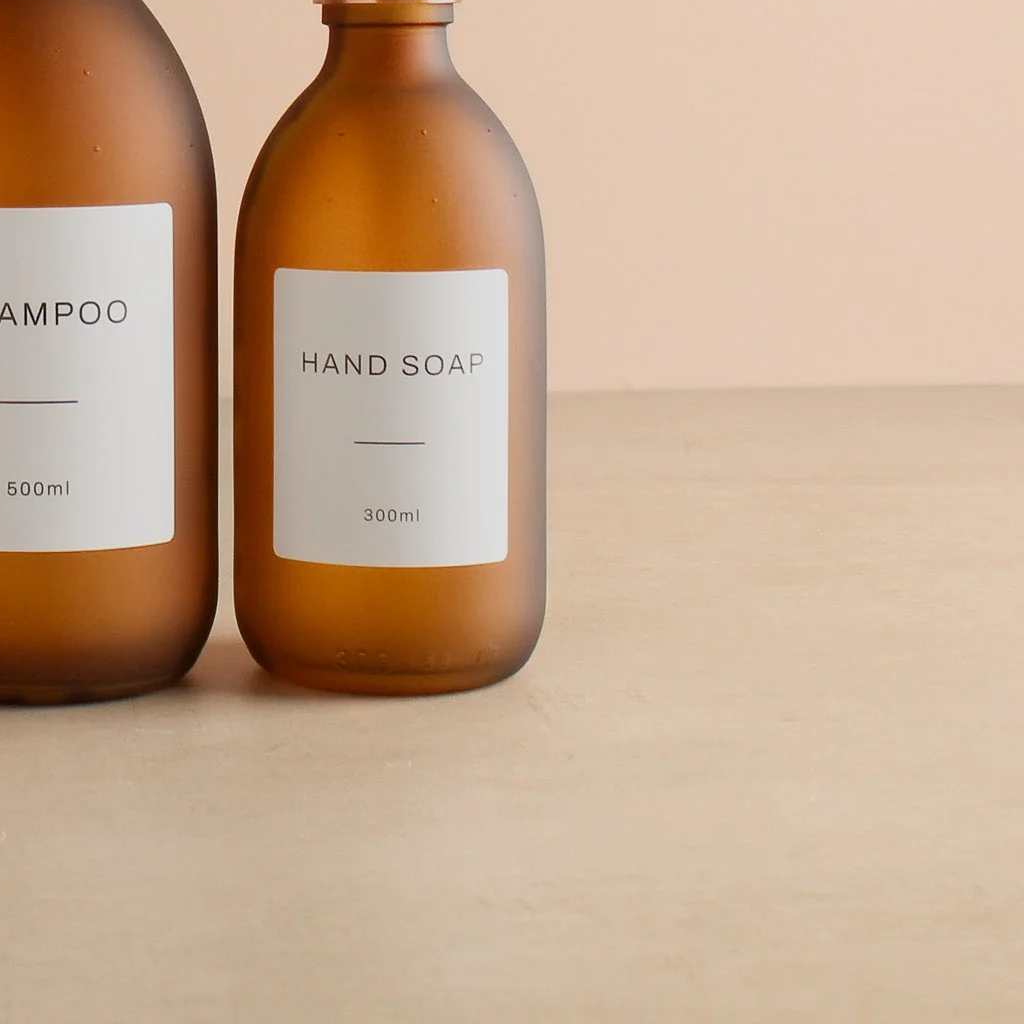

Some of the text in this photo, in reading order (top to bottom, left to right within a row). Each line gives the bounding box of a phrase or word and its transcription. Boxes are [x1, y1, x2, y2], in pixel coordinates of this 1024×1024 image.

[302, 351, 484, 376] HAND SOAP
[7, 480, 70, 497] 500ml
[363, 508, 420, 523] 300ml
